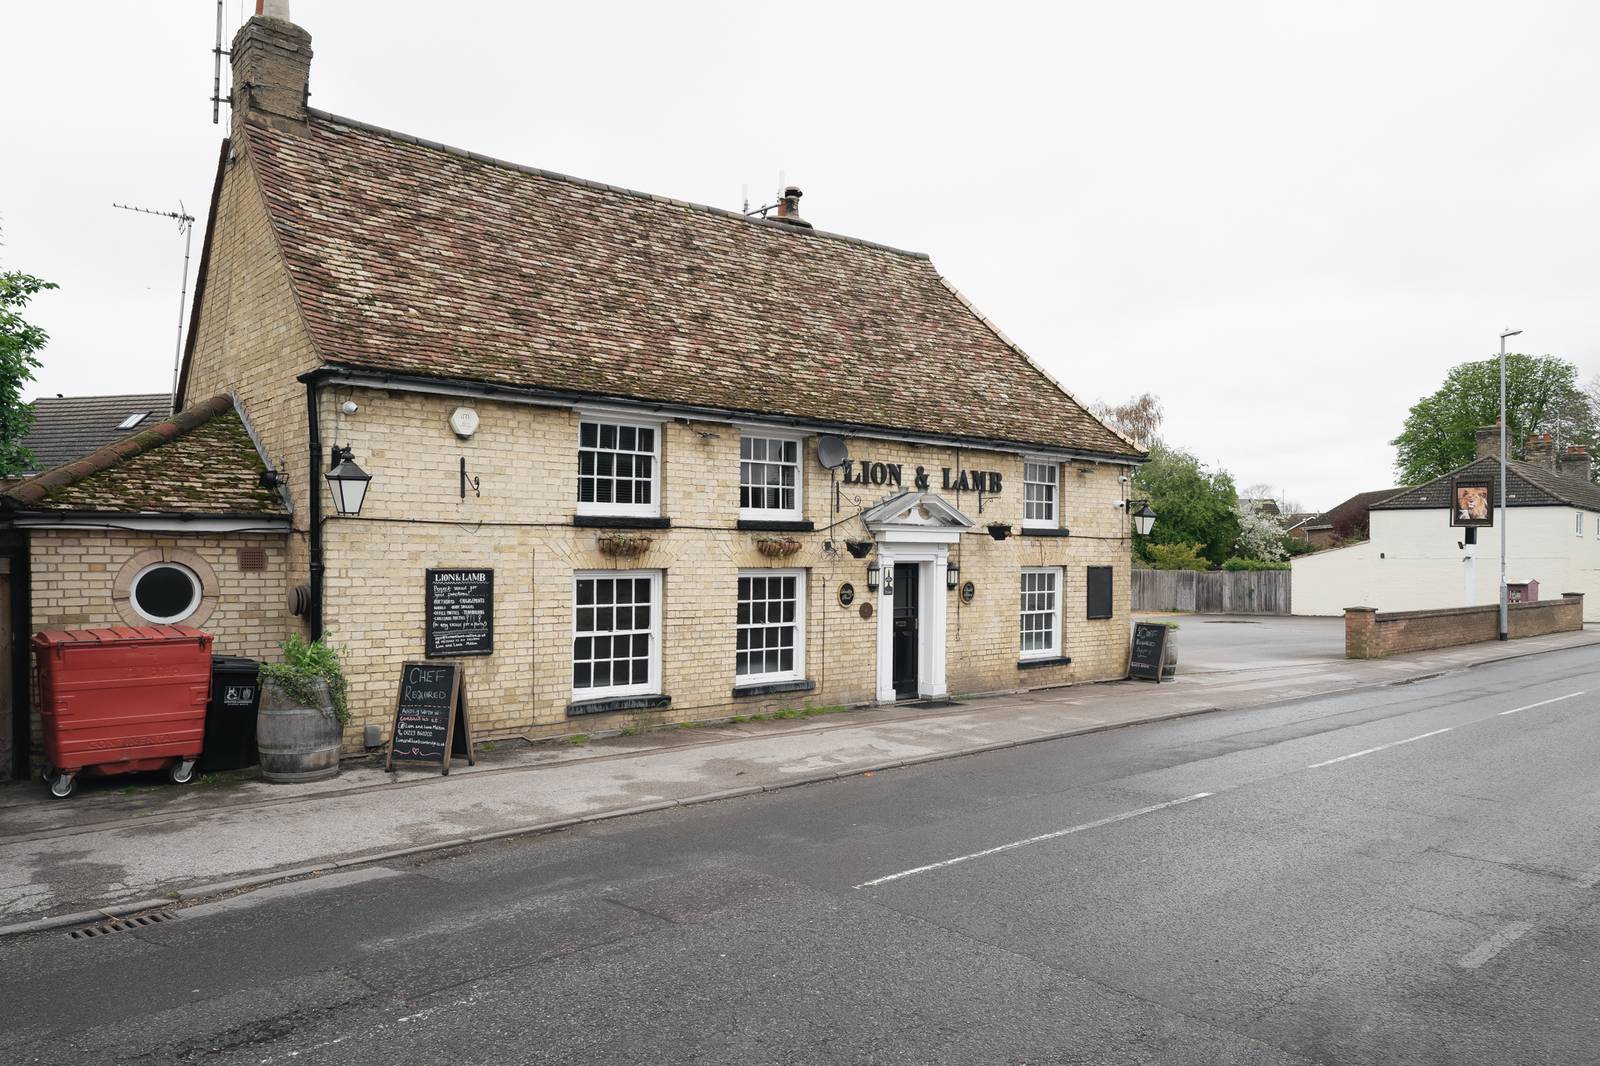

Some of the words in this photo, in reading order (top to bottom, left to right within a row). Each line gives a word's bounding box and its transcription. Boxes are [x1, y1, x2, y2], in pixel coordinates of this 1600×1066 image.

[842, 459, 903, 486] LION
[915, 466, 930, 490] &
[942, 467, 1003, 493] LAMB
[410, 667, 447, 685] CHEF
